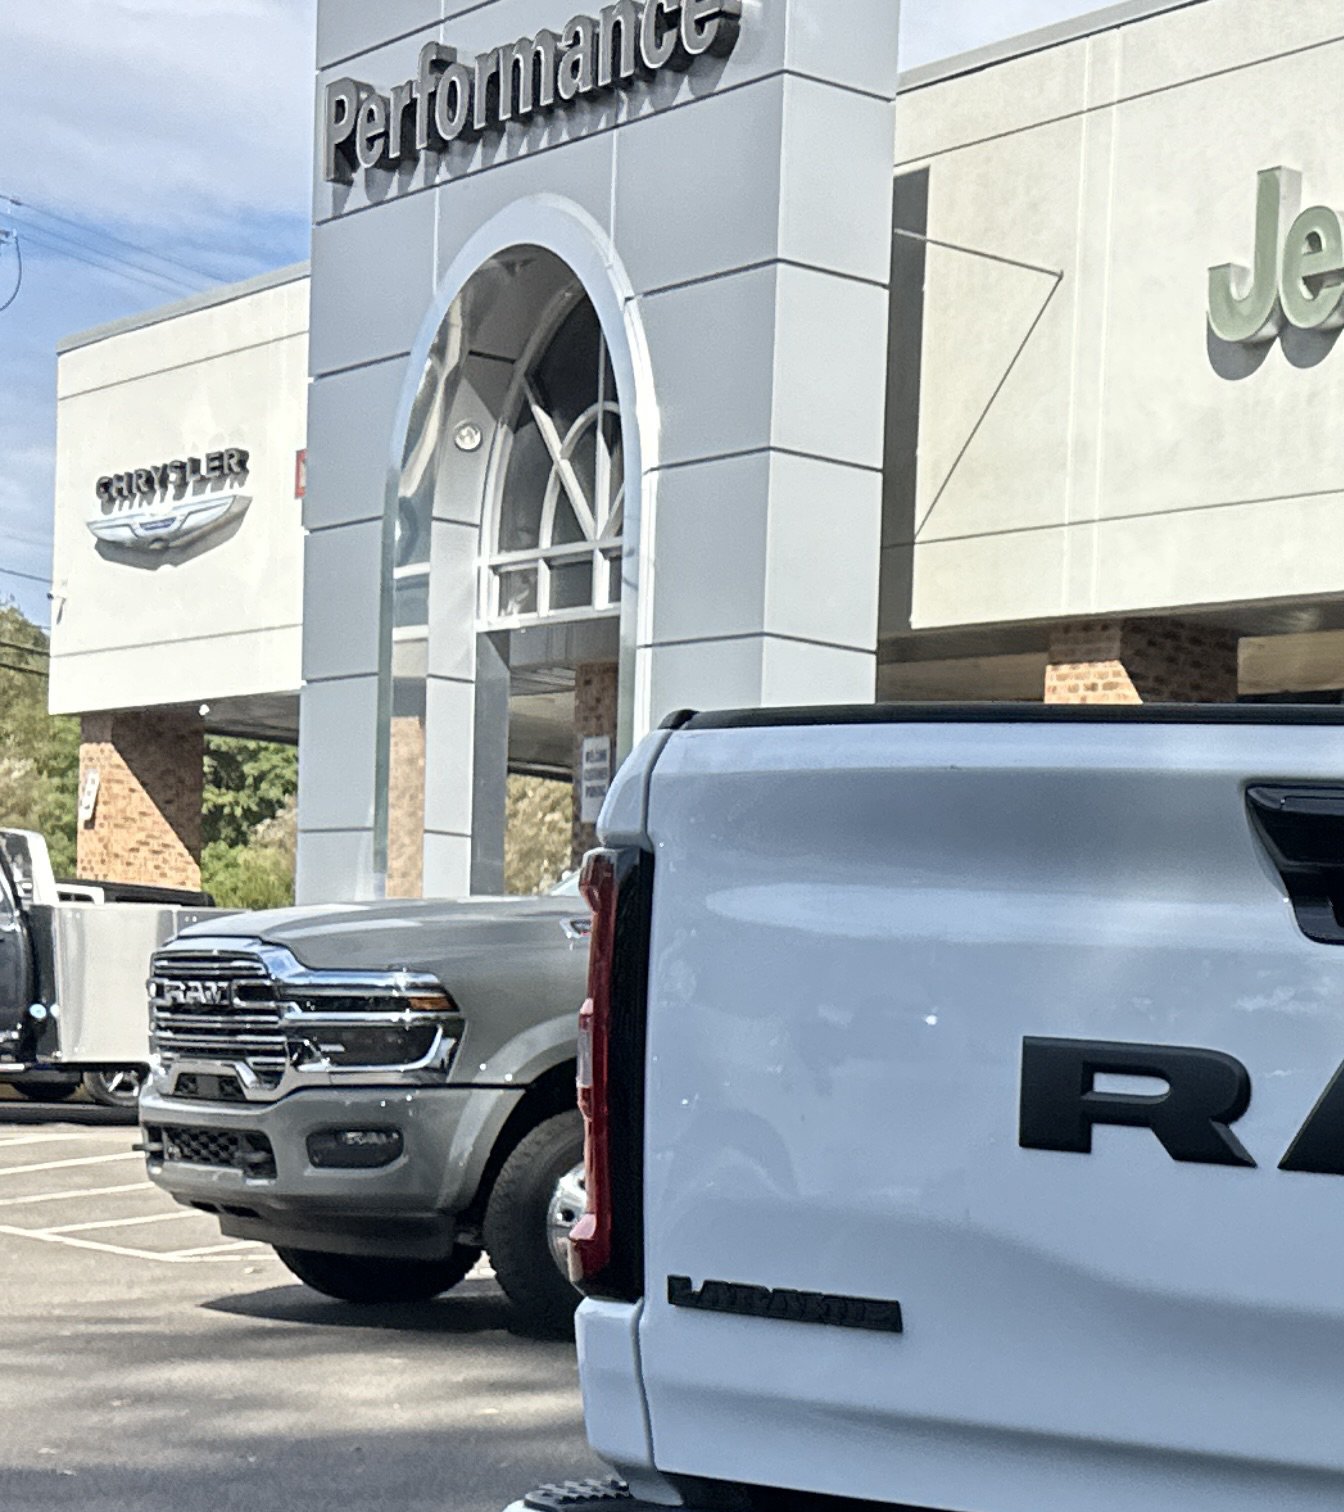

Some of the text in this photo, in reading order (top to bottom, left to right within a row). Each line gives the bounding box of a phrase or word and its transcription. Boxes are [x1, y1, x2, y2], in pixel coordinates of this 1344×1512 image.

[326, 0, 741, 182] Performance
[96, 448, 249, 501] CHRYSLER
[163, 980, 231, 1005] RAM
